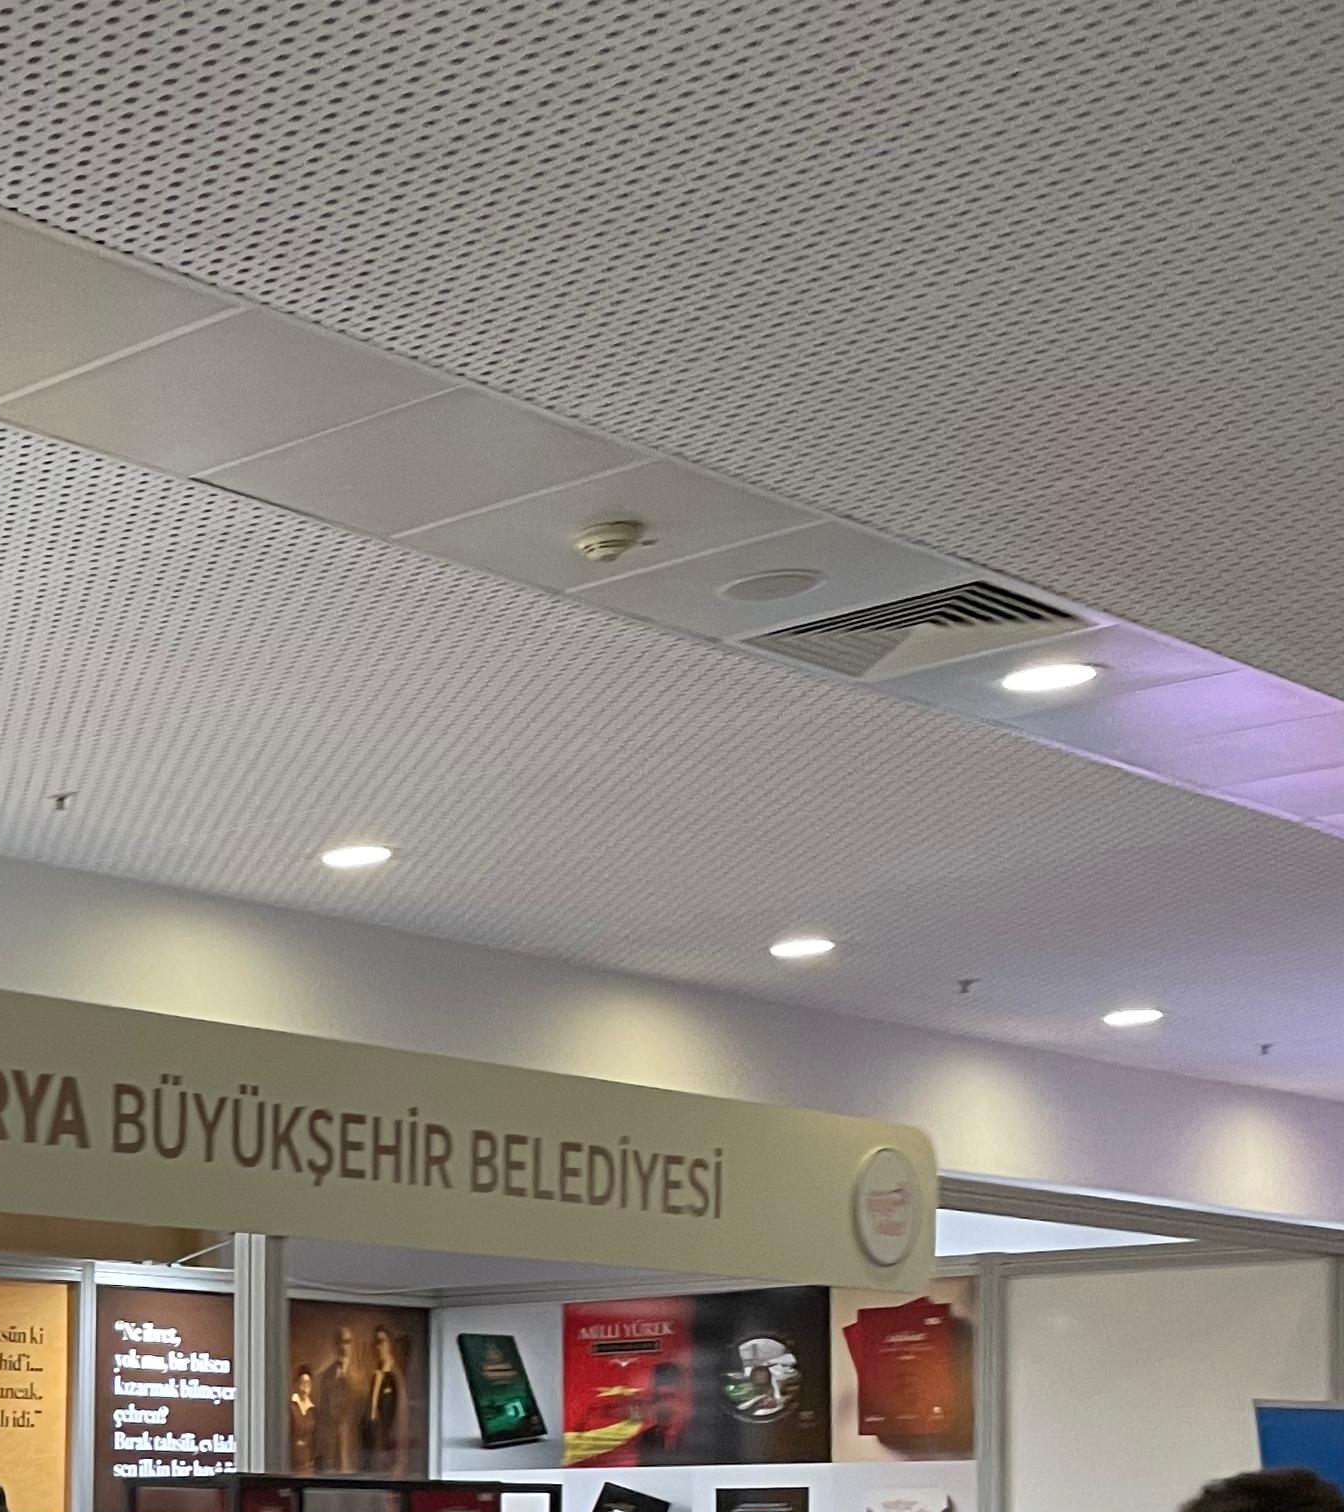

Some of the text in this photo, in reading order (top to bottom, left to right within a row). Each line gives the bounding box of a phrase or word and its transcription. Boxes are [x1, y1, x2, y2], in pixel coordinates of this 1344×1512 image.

[113, 1073, 453, 1189] BÜYÜKŞEHİR
[469, 1129, 724, 1219] BELEDİYESİ
[29, 1326, 44, 1345] ki
[168, 1350, 190, 1372] bir
[171, 1459, 193, 1478] bir
